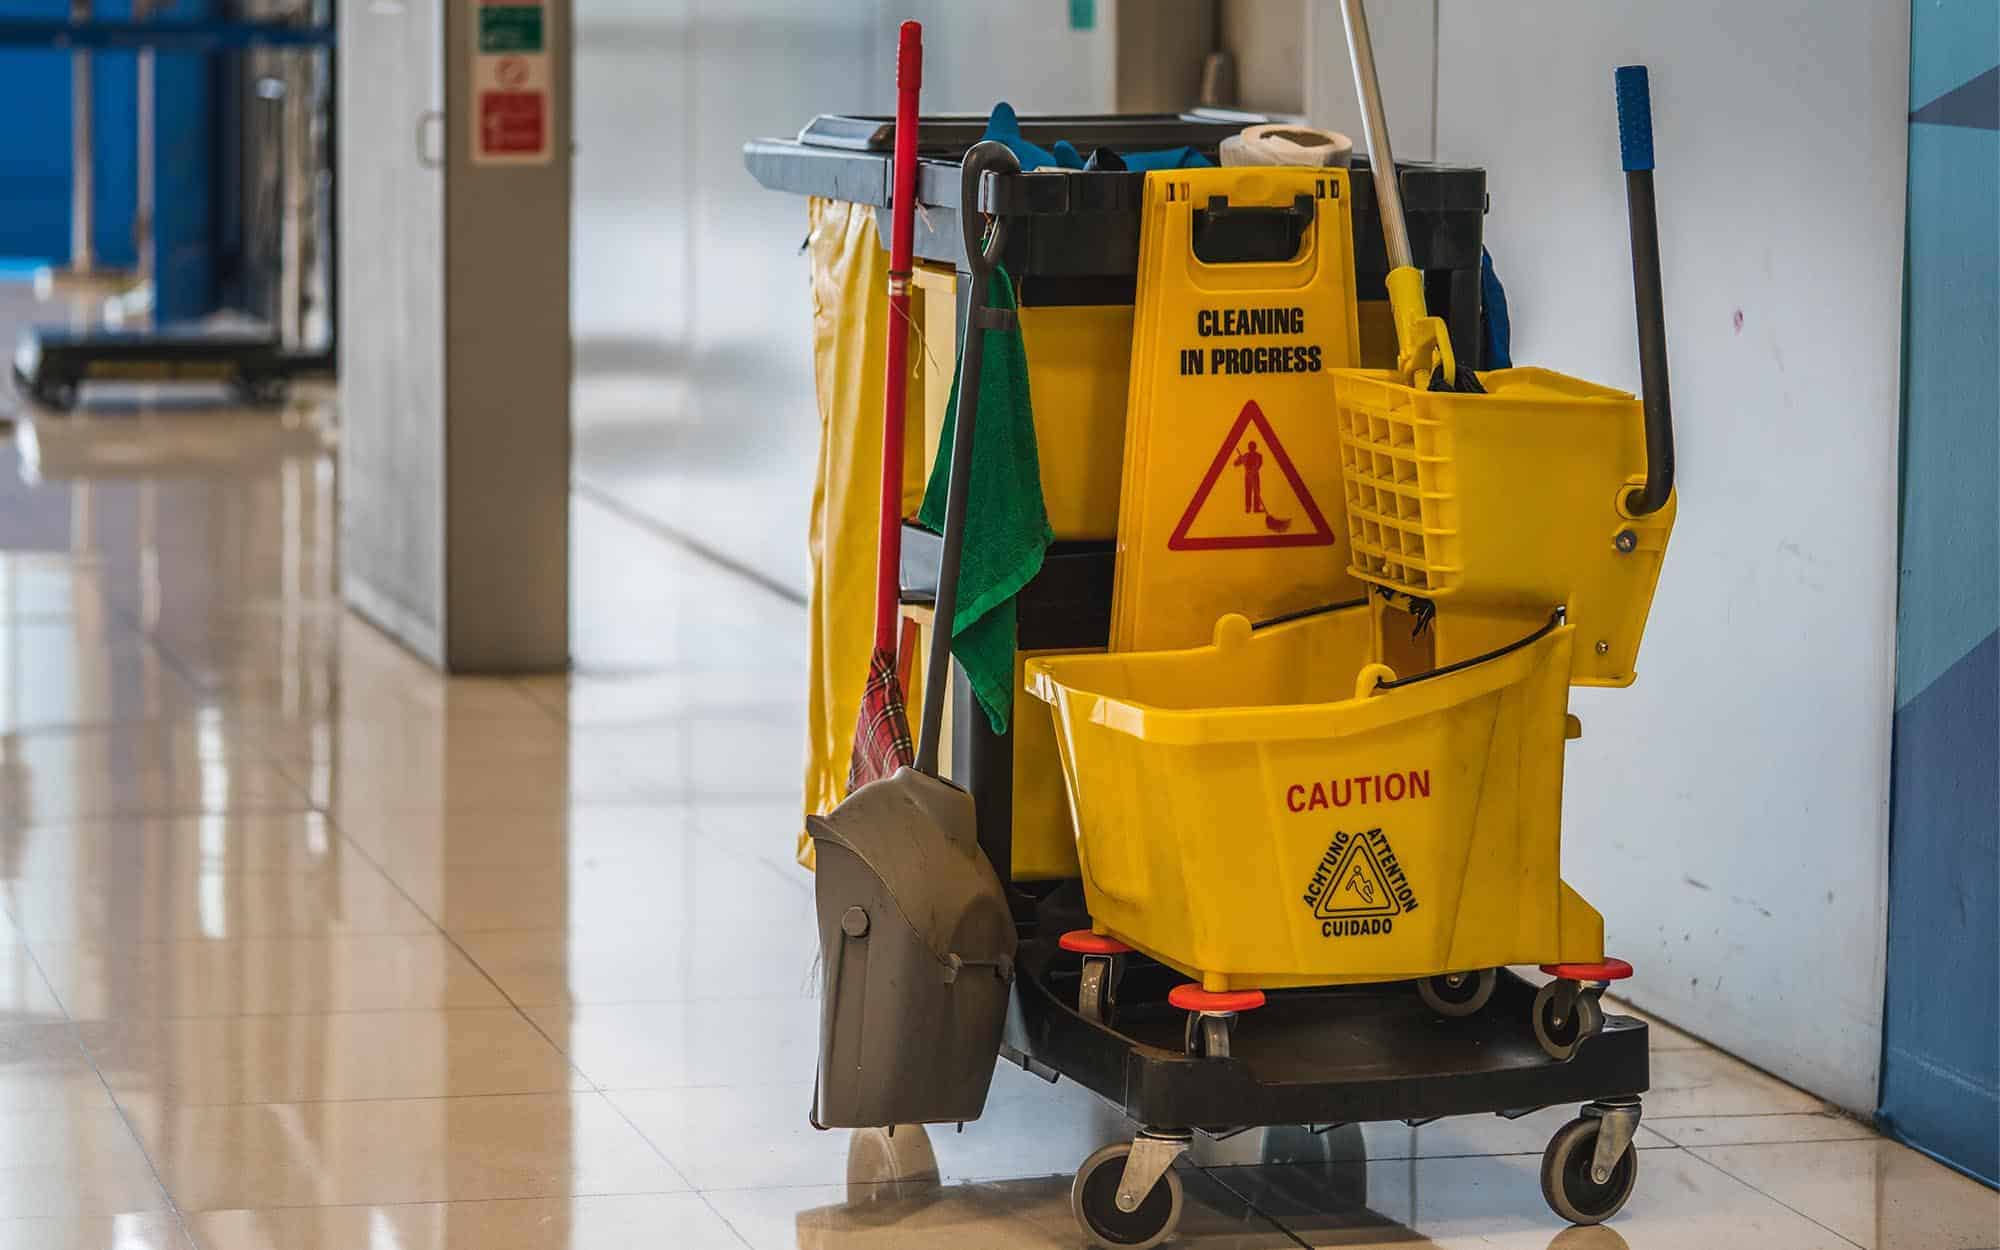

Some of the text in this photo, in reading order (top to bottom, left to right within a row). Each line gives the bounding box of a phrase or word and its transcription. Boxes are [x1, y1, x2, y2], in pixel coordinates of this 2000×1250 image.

[1198, 308, 1304, 337] CLEANING
[1180, 346, 1322, 375] IN PROGRESS
[1286, 769, 1431, 813] CAUTION
[1302, 830, 1350, 908] ACHTUNG
[1367, 827, 1419, 913] ATTENTION
[1322, 918, 1393, 938] CUIDADO
